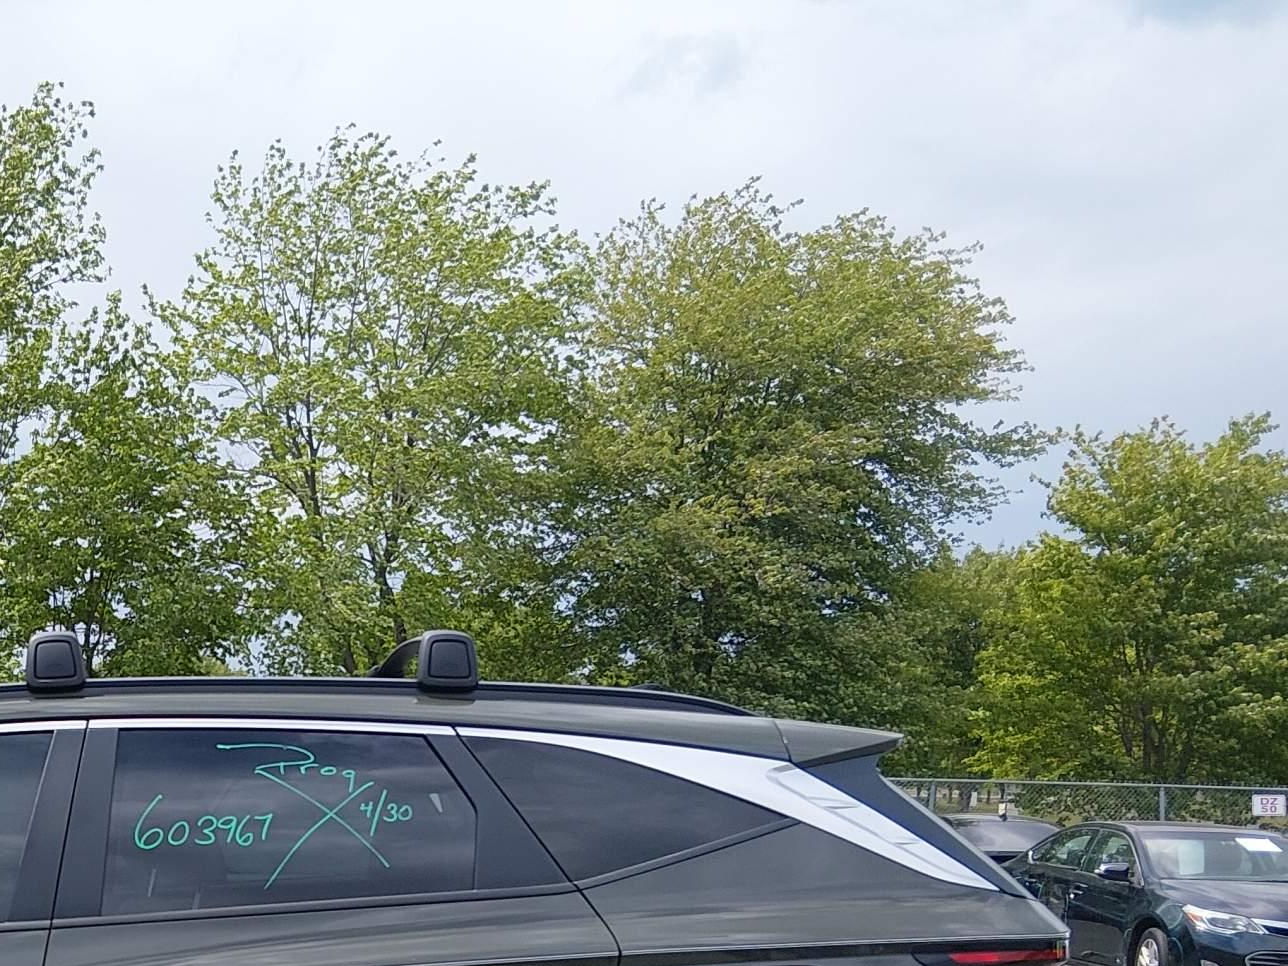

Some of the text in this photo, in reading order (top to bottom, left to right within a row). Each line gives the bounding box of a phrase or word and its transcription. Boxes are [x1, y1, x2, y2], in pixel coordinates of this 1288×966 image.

[133, 793, 273, 850] 603967
[359, 788, 413, 837] 4/30
[1260, 797, 1278, 806] DZ
